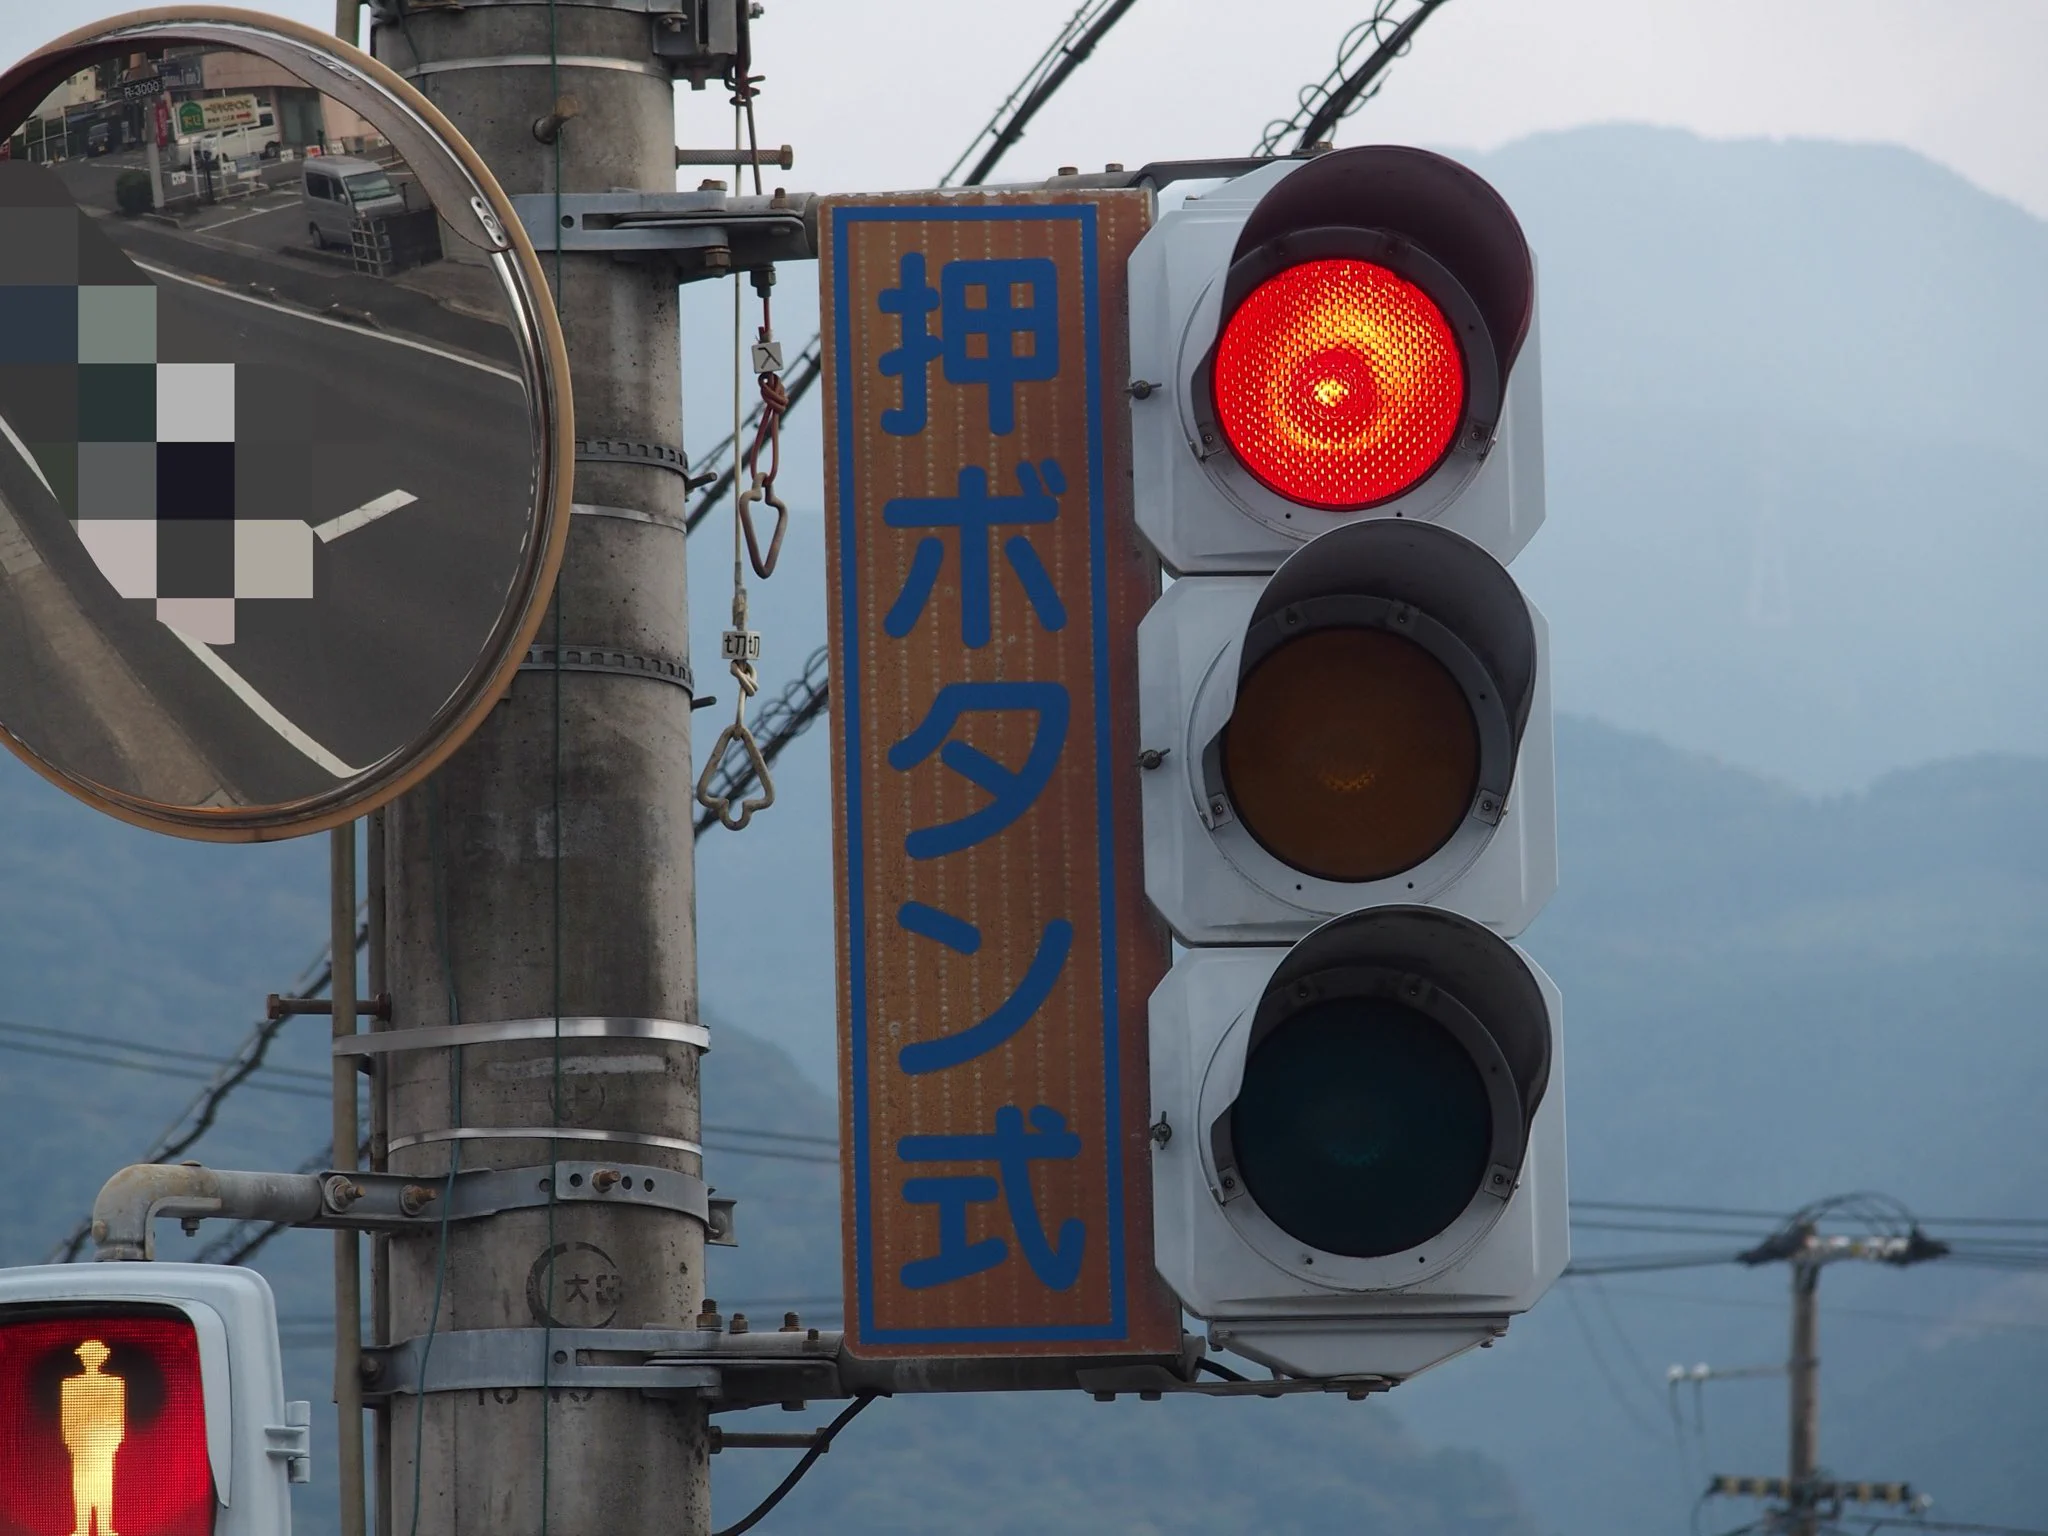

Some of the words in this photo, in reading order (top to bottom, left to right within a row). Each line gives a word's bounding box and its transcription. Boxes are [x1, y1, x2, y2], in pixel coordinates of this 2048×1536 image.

[877, 251, 1088, 1293] 押ボタン式
